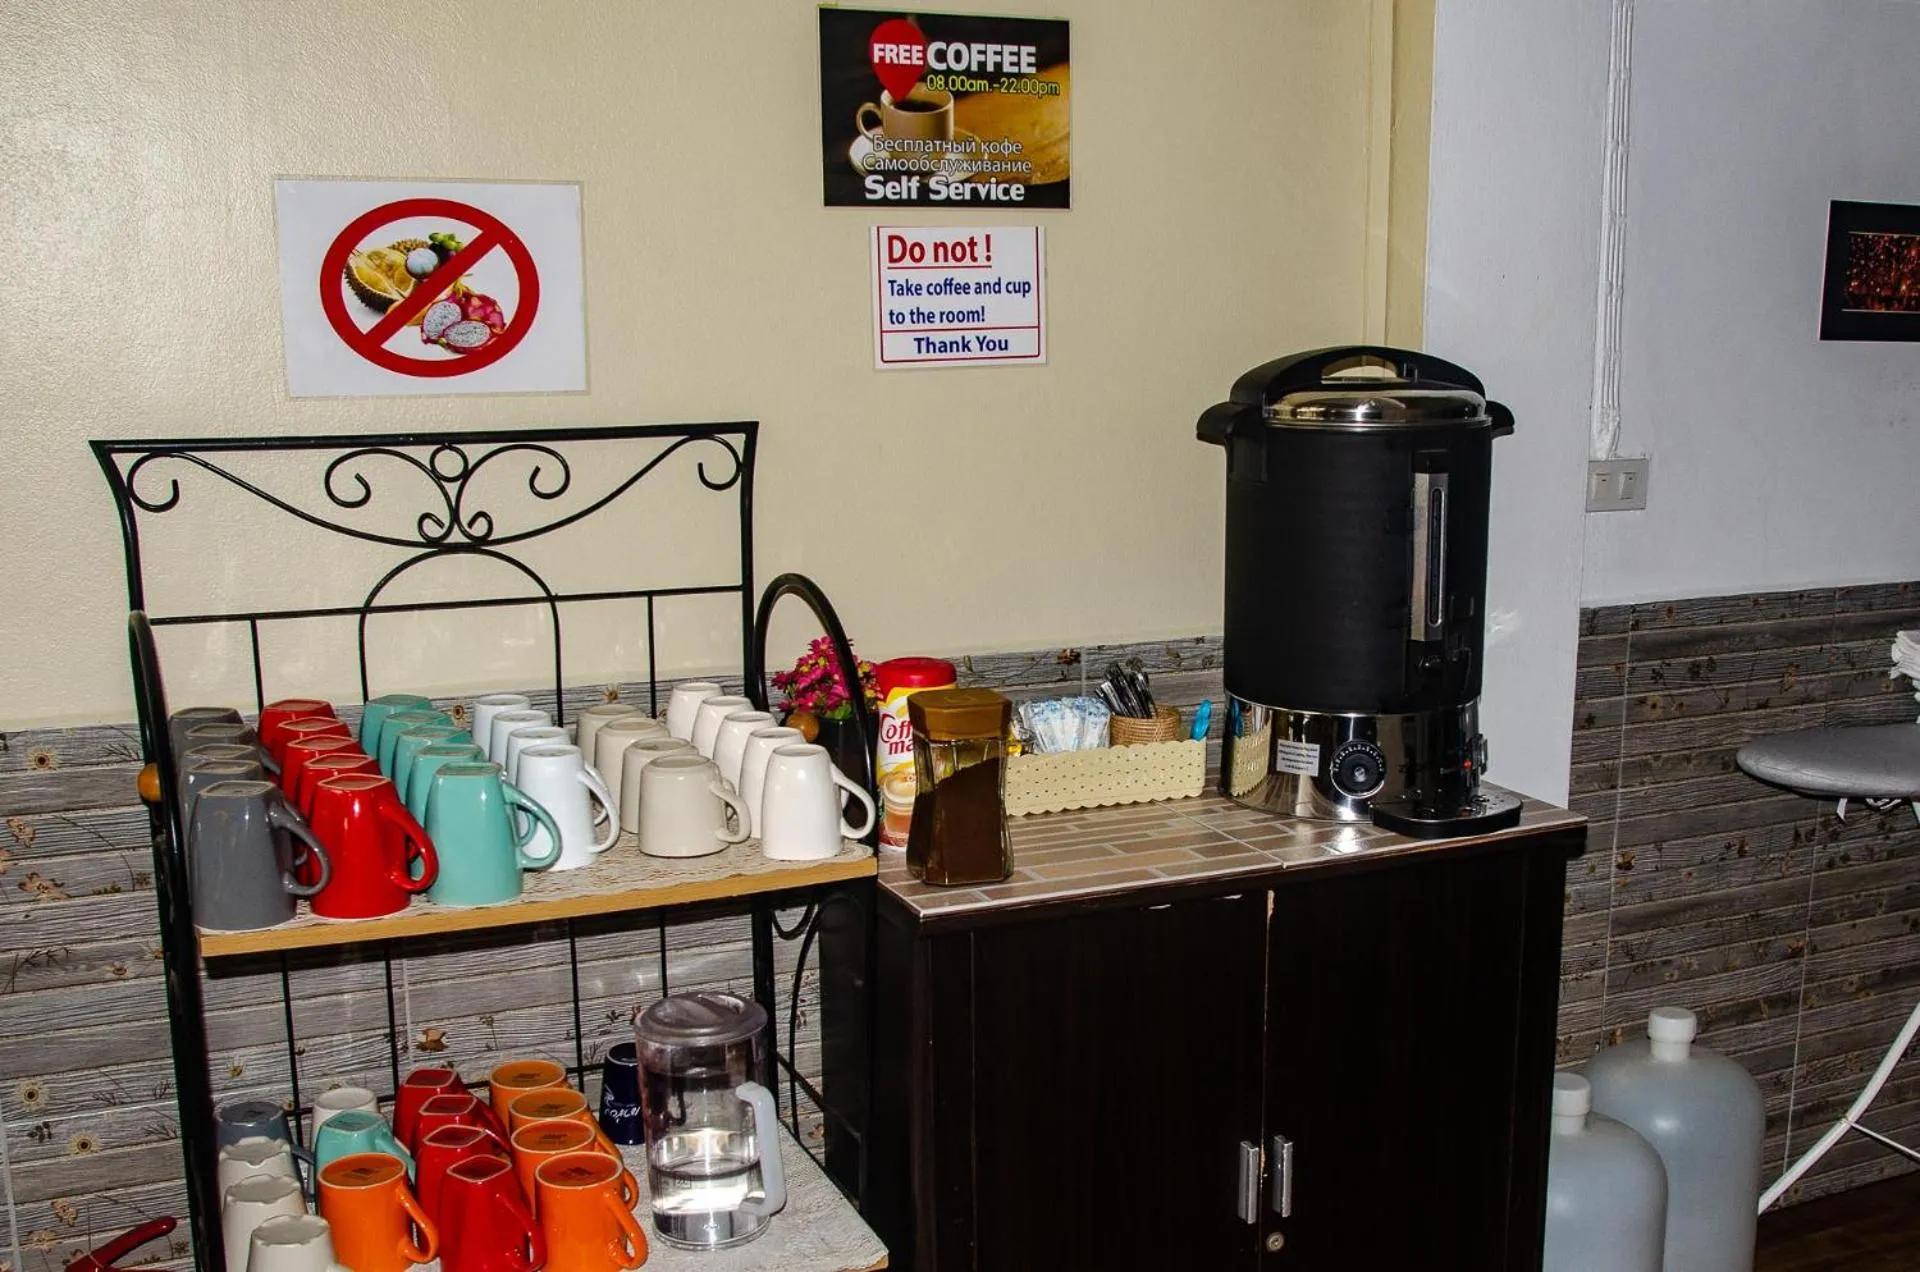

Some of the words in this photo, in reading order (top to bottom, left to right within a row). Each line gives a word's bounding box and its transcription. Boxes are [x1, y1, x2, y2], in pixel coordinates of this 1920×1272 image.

[873, 43, 924, 65] FREE
[926, 41, 1037, 74] COFFEE
[872, 135, 976, 154] Бесплатный
[980, 137, 1022, 158] кофе
[862, 154, 1032, 174] Самообслуживание
[864, 175, 920, 200] Self
[929, 176, 1025, 201] Service
[887, 234, 925, 264] Do
[933, 236, 978, 263] not
[888, 278, 922, 296] Take
[927, 277, 971, 295] coffee
[974, 277, 1002, 294] and
[1005, 280, 1031, 298] cup
[889, 309, 906, 324] to
[909, 307, 935, 324] the
[940, 306, 985, 323] room!
[913, 335, 972, 354] Thank
[975, 336, 1009, 352] You
[880, 713, 914, 743] Coff
[889, 740, 914, 755] ma
